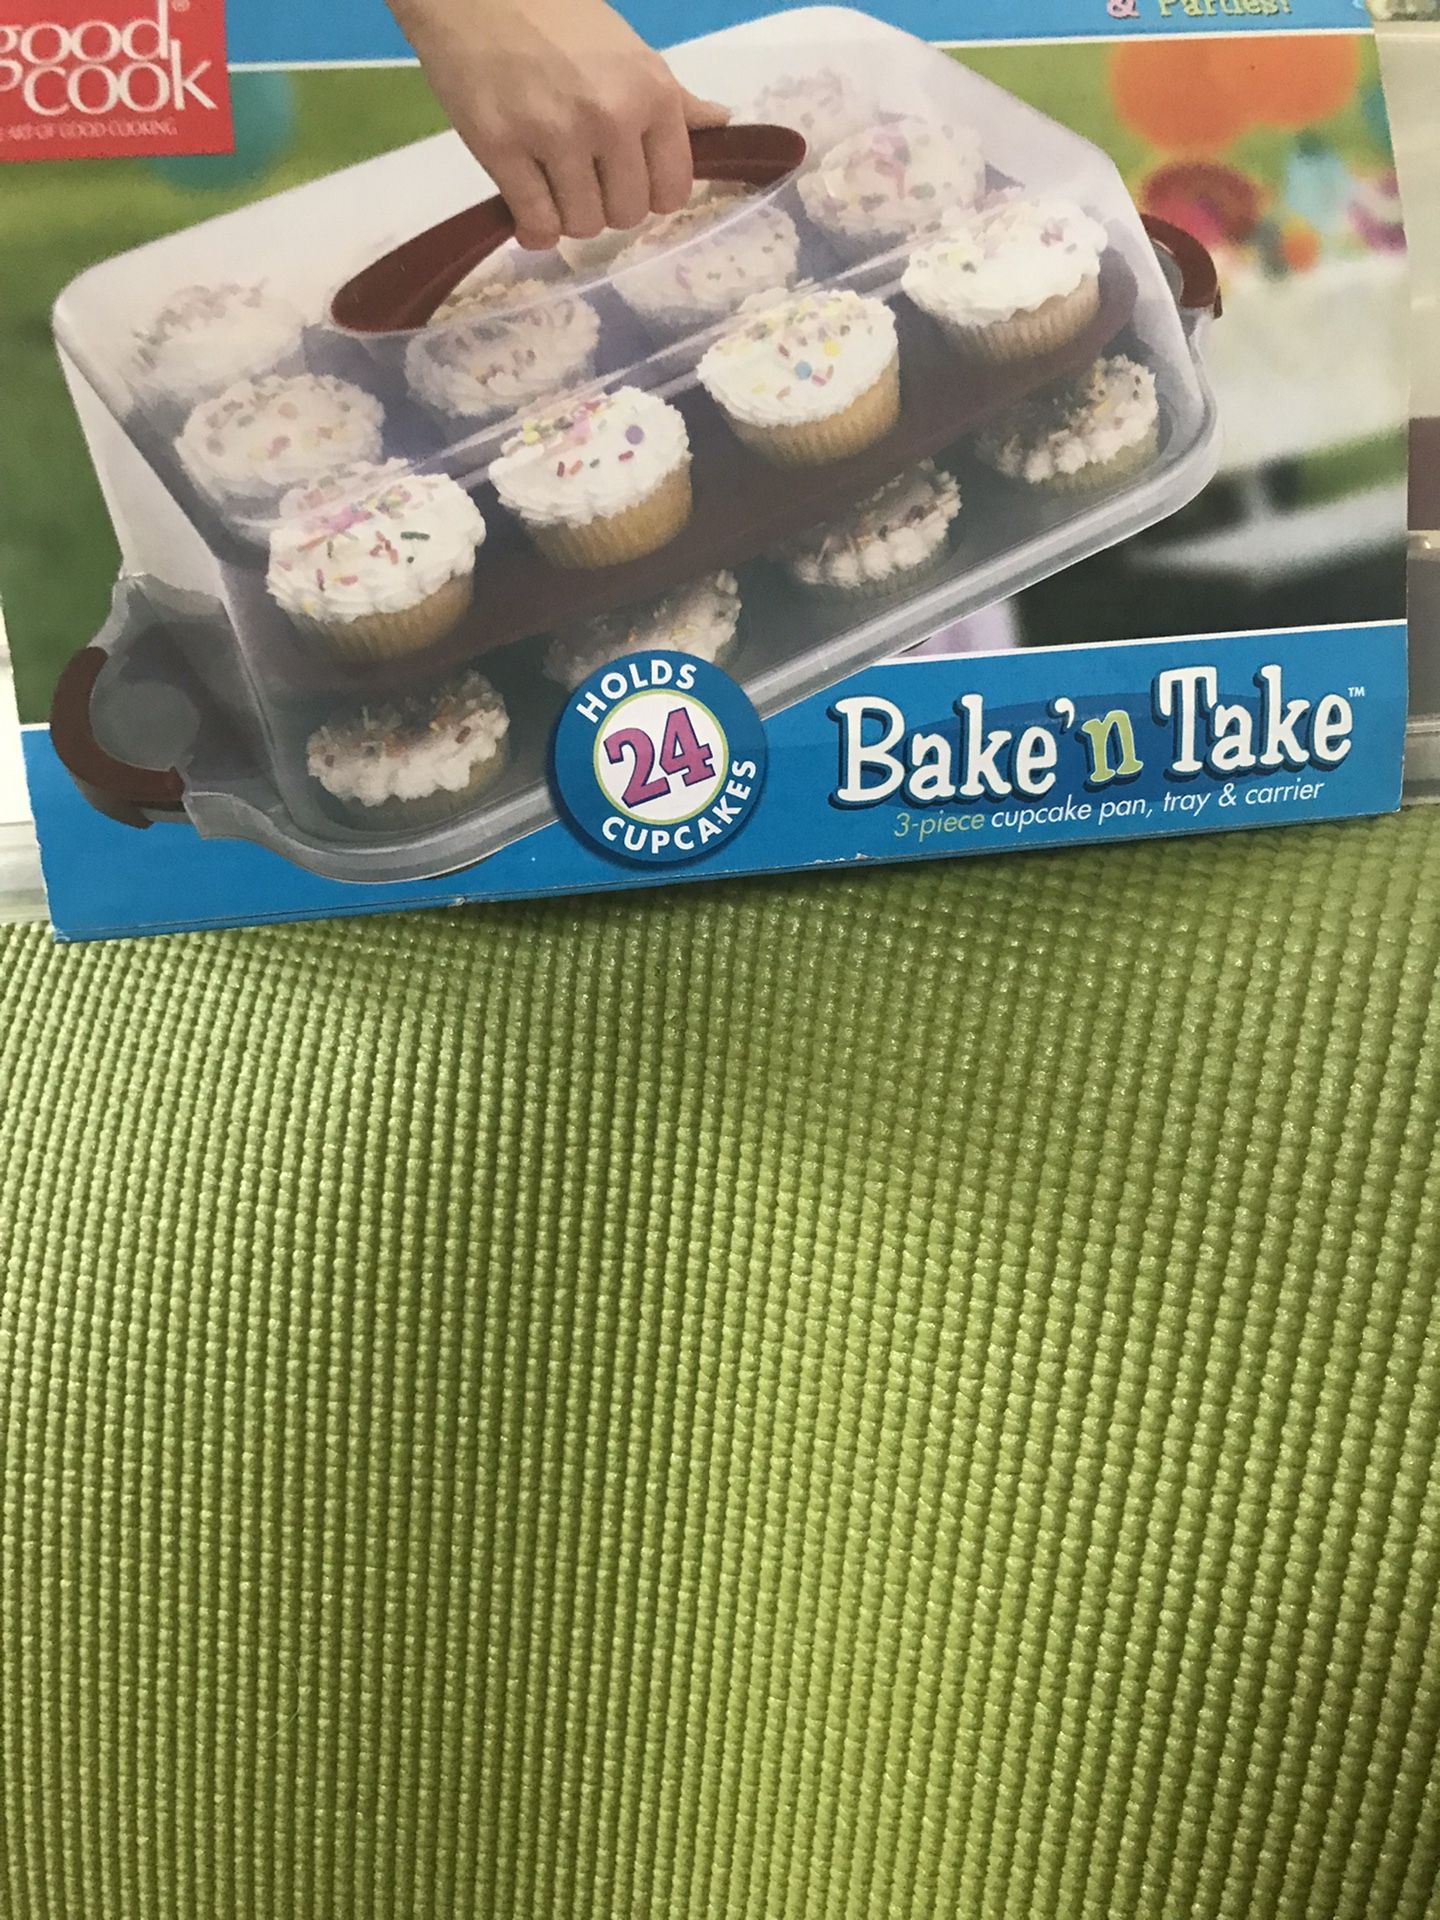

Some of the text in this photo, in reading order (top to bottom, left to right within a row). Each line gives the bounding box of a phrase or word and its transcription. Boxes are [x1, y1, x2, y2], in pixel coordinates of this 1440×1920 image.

[23, 39, 219, 116] cook
[576, 659, 697, 723] HOLDS
[1158, 663, 1353, 773] Take
[603, 706, 716, 809] 24
[602, 760, 757, 854] CUPCAKES
[894, 777, 1325, 843] 3-piece cupcake pan, tray & carrier
